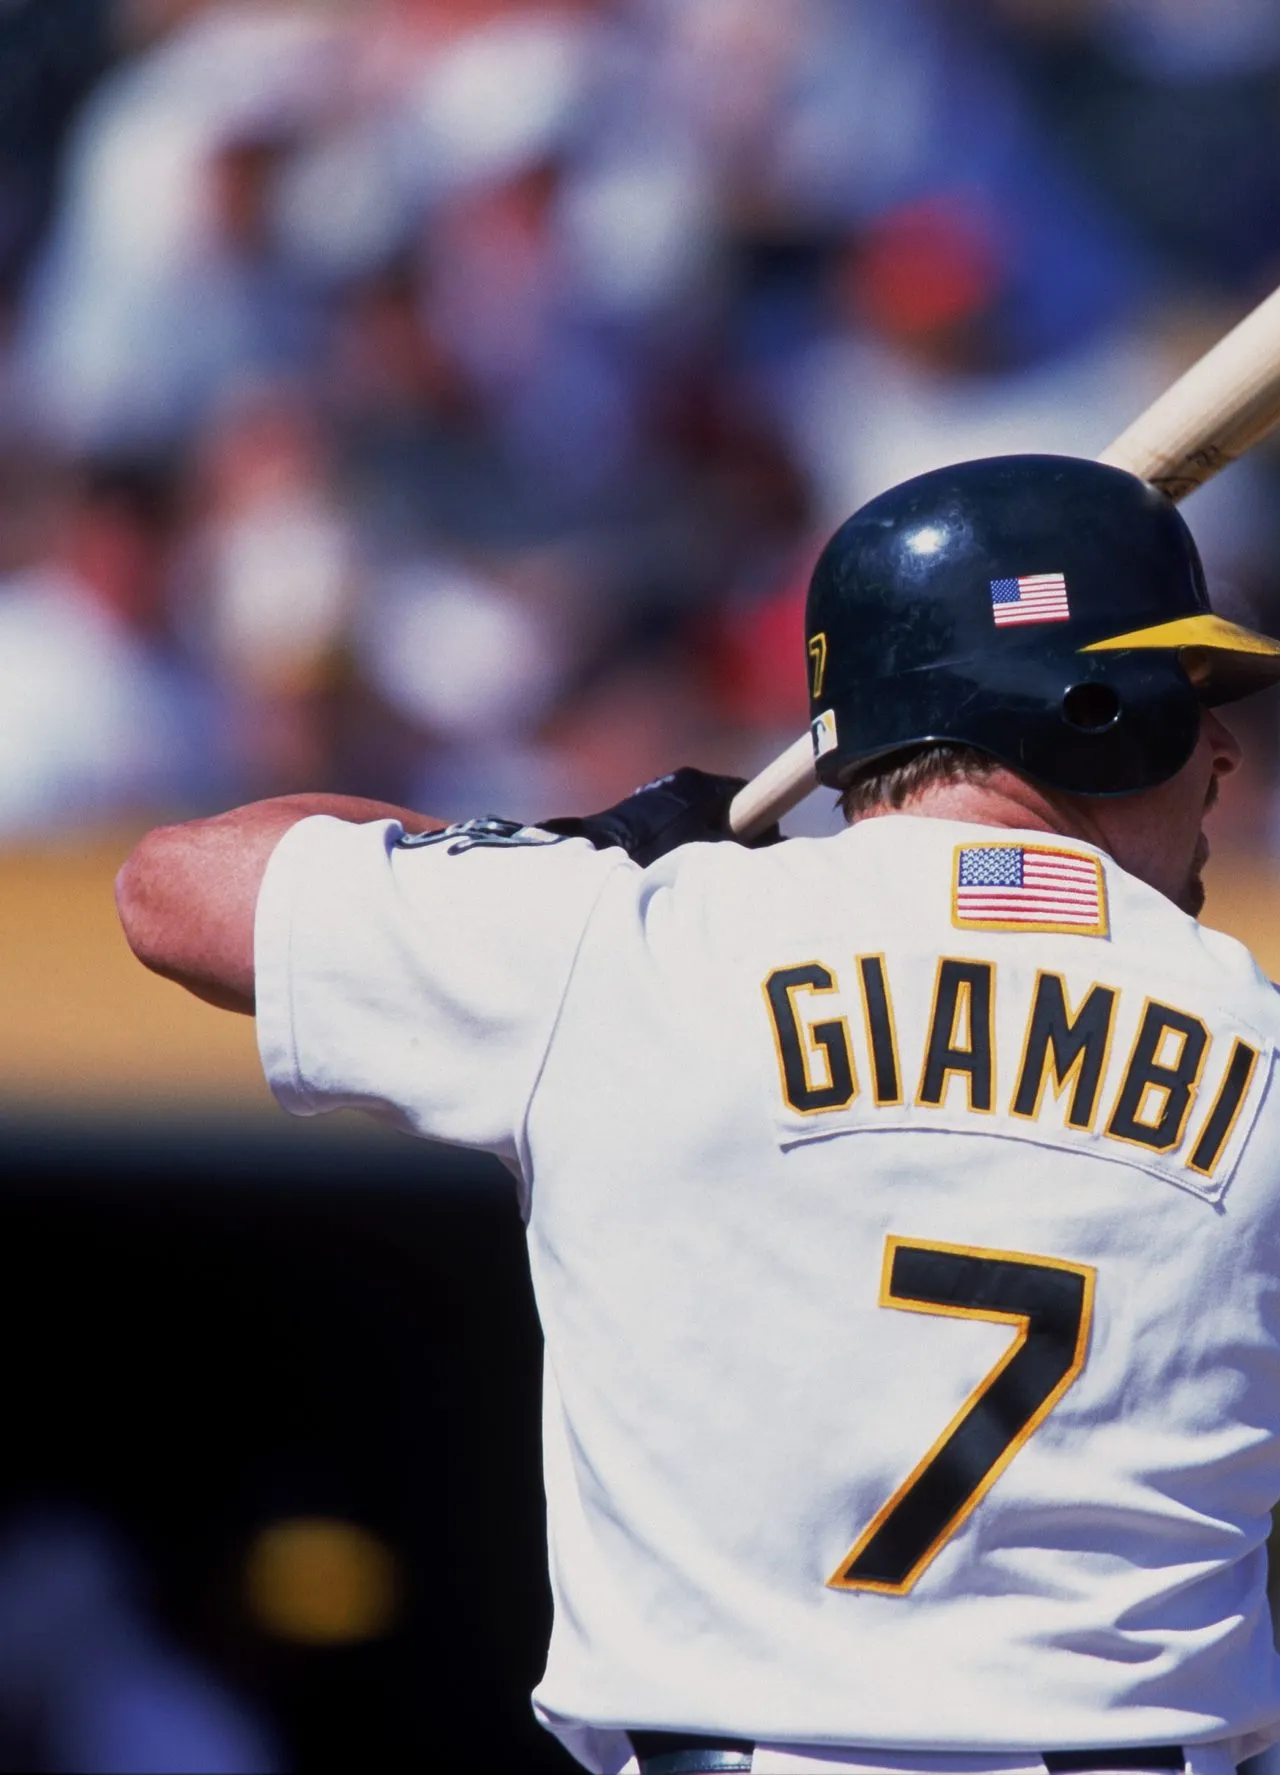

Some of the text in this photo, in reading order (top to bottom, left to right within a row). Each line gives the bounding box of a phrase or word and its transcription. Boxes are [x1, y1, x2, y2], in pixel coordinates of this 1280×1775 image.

[808, 632, 827, 699] 7
[761, 952, 1262, 1179] GIAMBI
[825, 1234, 1098, 1597] 7
